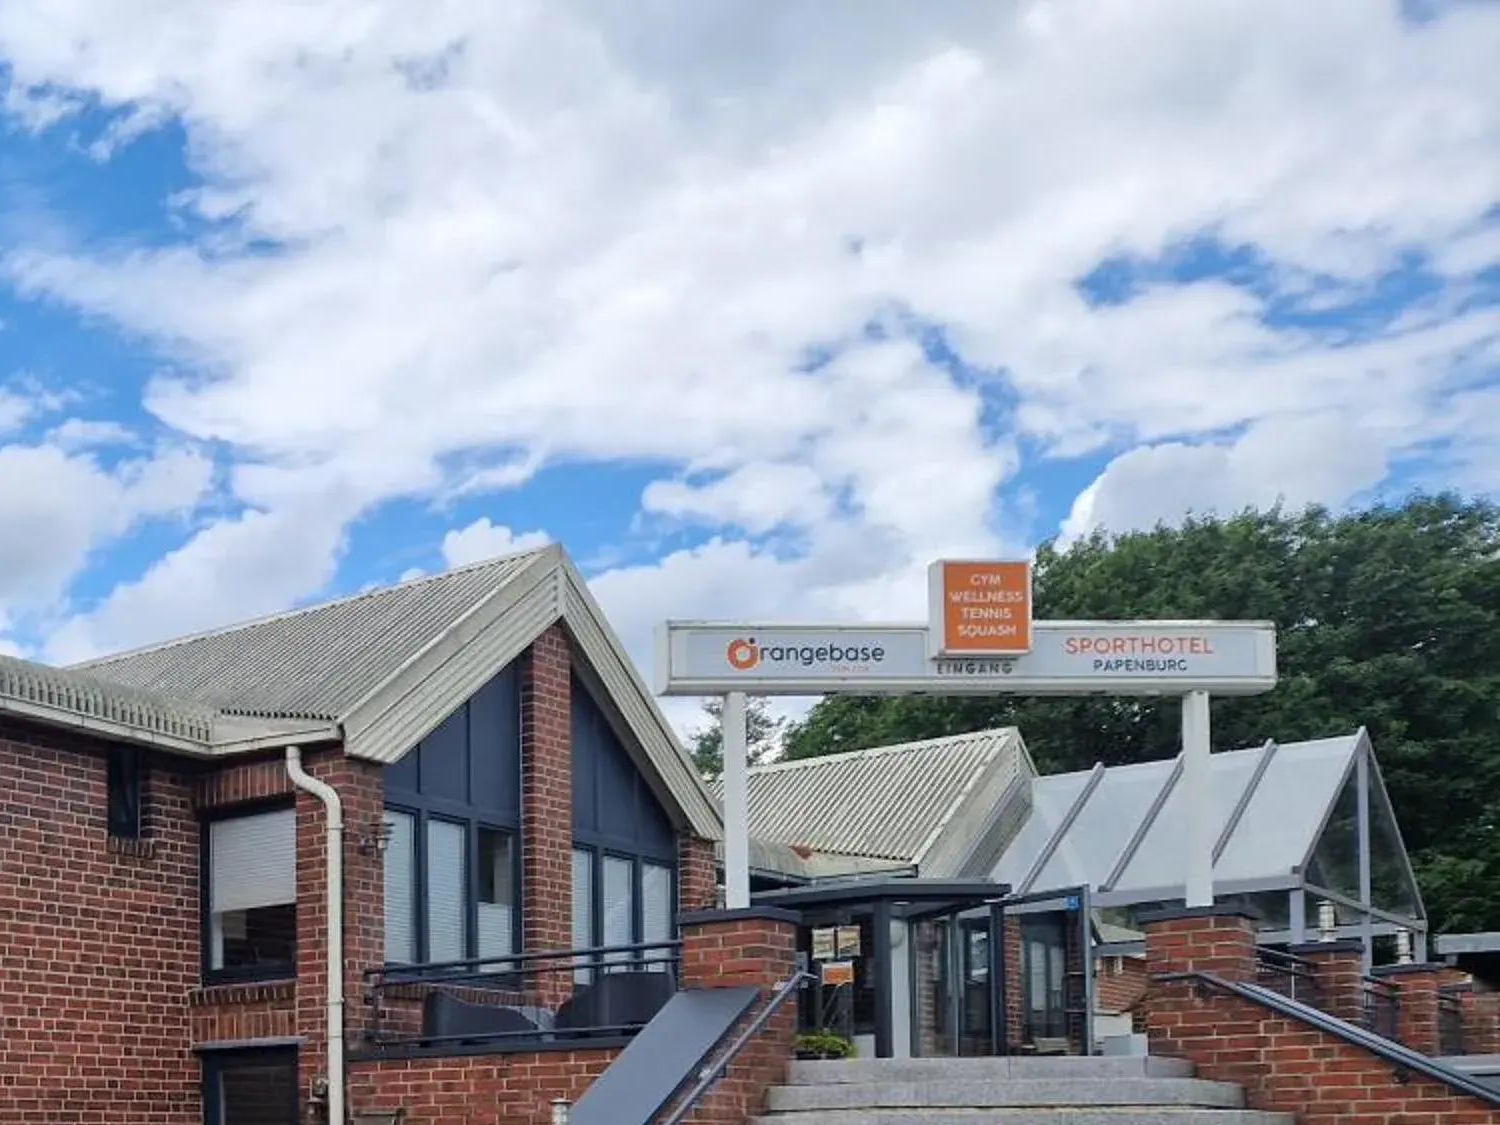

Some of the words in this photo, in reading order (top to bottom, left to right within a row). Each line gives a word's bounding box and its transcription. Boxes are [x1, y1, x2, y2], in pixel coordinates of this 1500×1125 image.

[949, 590, 1024, 603] WELLNESS
[961, 606, 1012, 620] TENNIS
[957, 624, 1017, 638] SQUASH
[1065, 636, 1214, 655] SPORTHOTEL
[937, 662, 1013, 675] EINGANG
